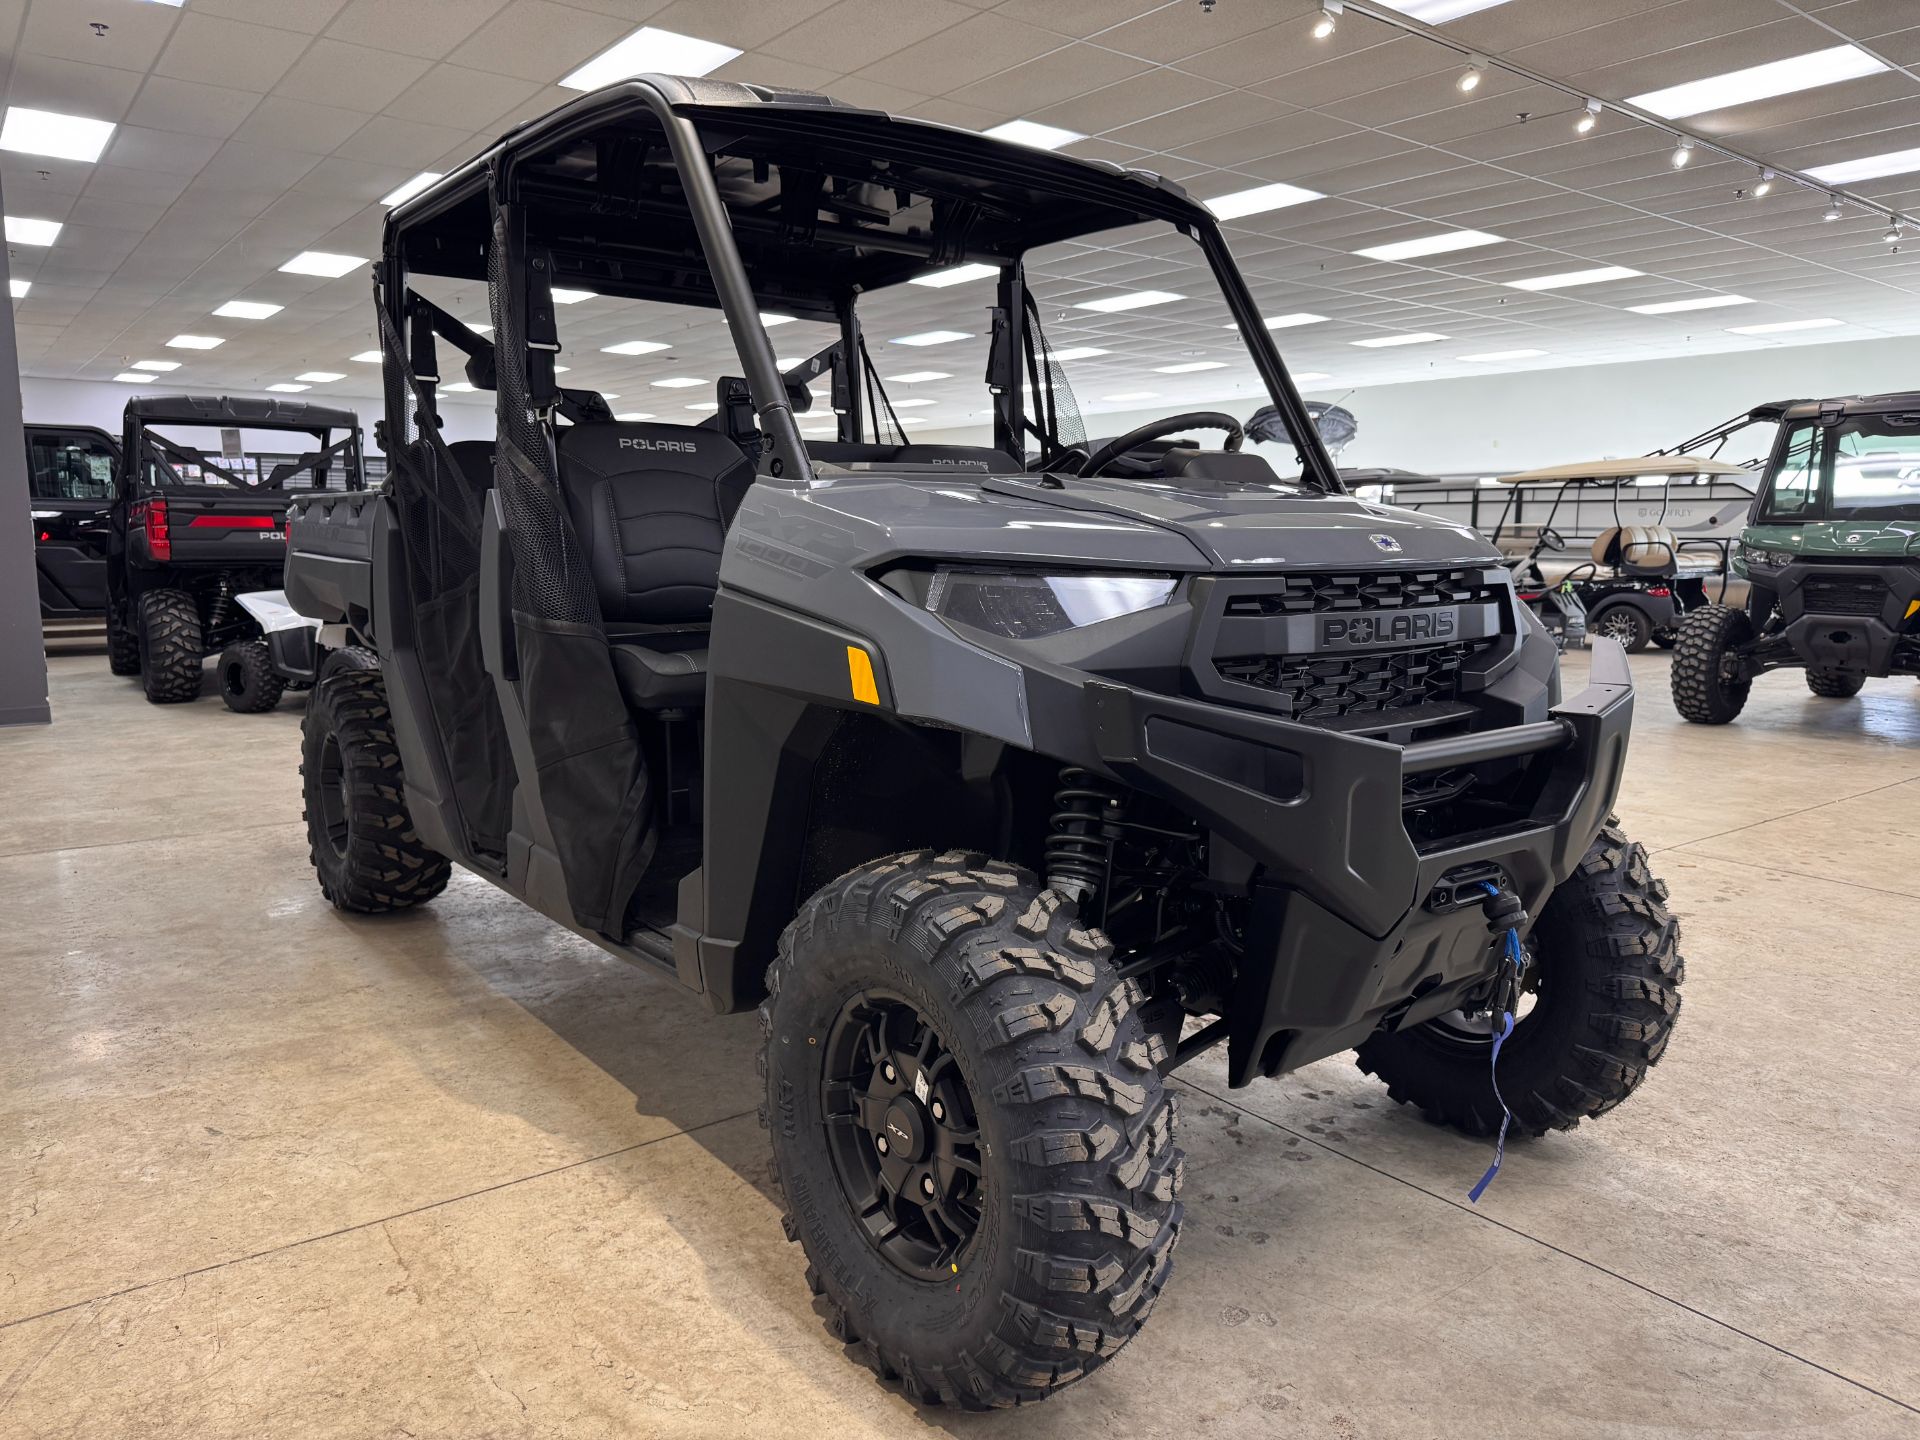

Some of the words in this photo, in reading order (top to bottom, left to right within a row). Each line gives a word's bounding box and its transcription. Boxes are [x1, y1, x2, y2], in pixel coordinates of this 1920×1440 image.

[619, 438, 697, 453] POLARIS
[1322, 611, 1454, 647] POLARIS
[887, 1122, 909, 1140] XP
